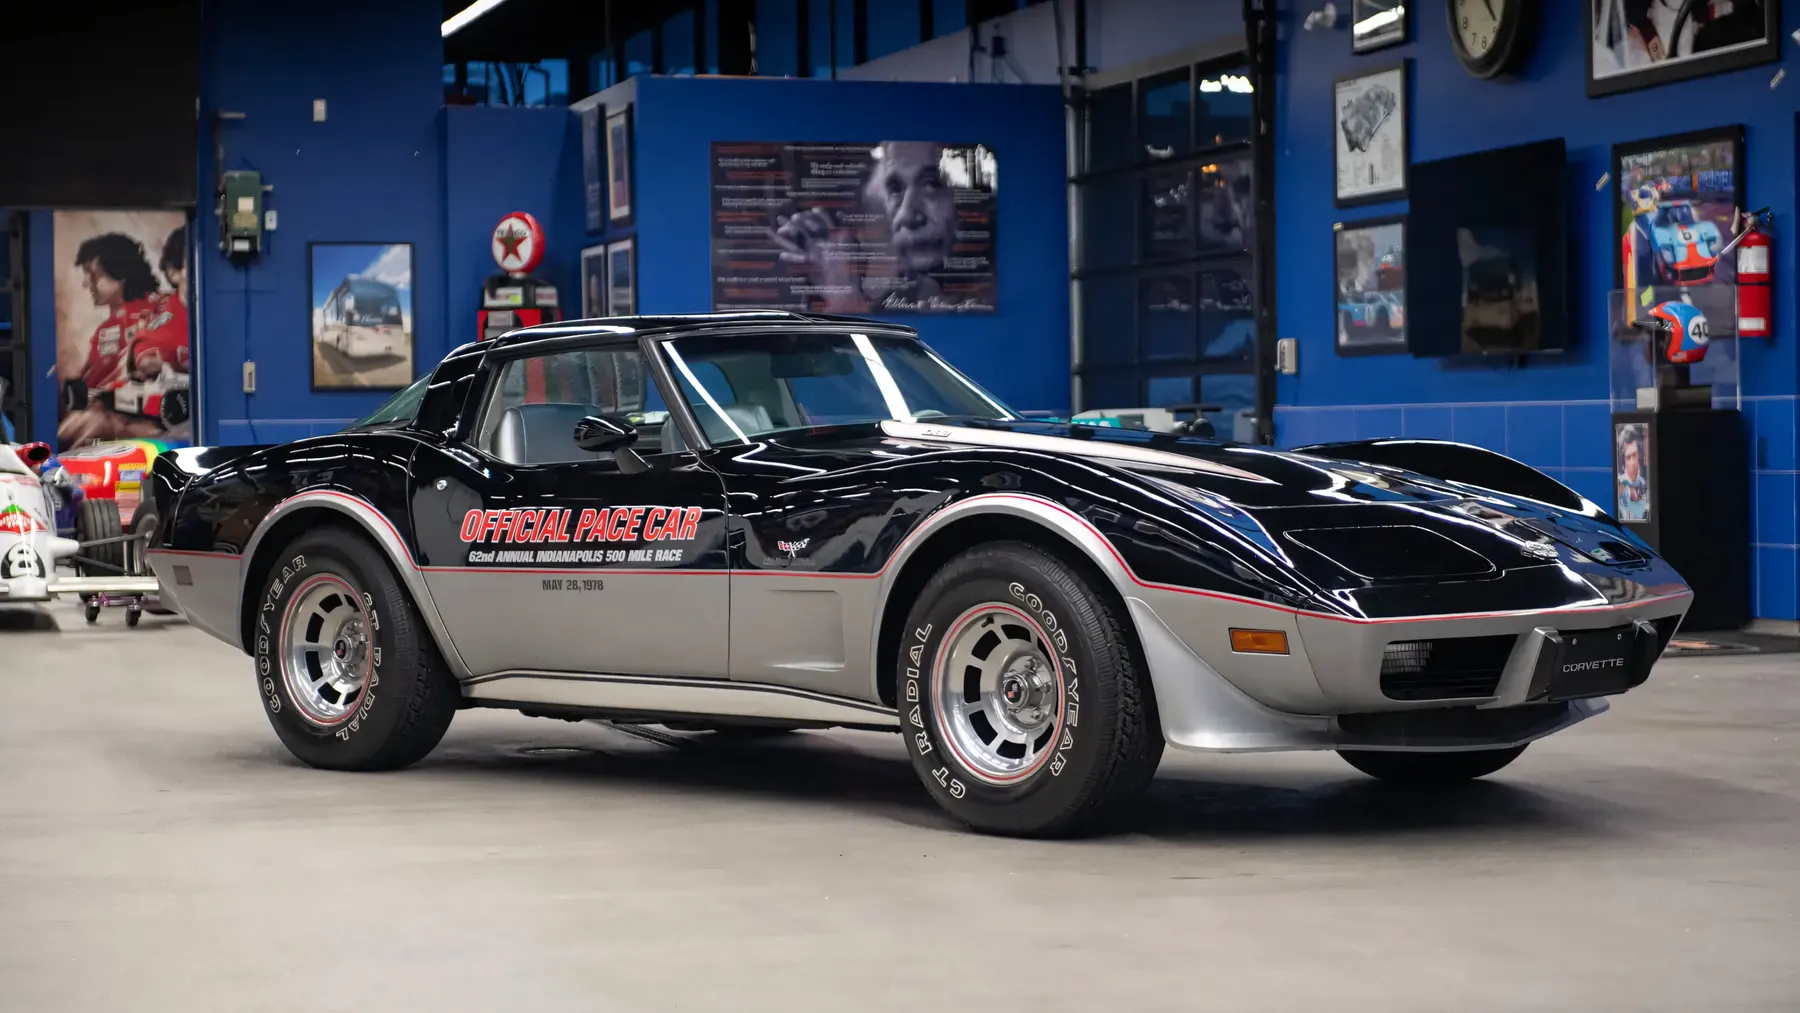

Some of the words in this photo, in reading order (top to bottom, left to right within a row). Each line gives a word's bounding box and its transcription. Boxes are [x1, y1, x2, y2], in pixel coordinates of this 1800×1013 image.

[1462, 16, 1468, 29] 8
[1472, 32, 1477, 45] 7
[460, 508, 572, 543] OFFICIAL
[573, 507, 646, 542] PACE
[643, 506, 702, 541] CAR
[469, 550, 495, 562] 62nd
[495, 550, 534, 563] ANNUAL
[536, 550, 603, 563] INDIANAPOLIS
[605, 550, 626, 562] 500
[628, 549, 653, 562] MILE
[655, 549, 683, 561] RACE
[542, 579, 563, 591] MAY
[363, 592, 380, 631] GT
[1562, 657, 1624, 673] CORVETTE
[335, 647, 382, 741] RADIAL
[906, 623, 933, 755] RADIAL
[932, 766, 966, 798] GT
